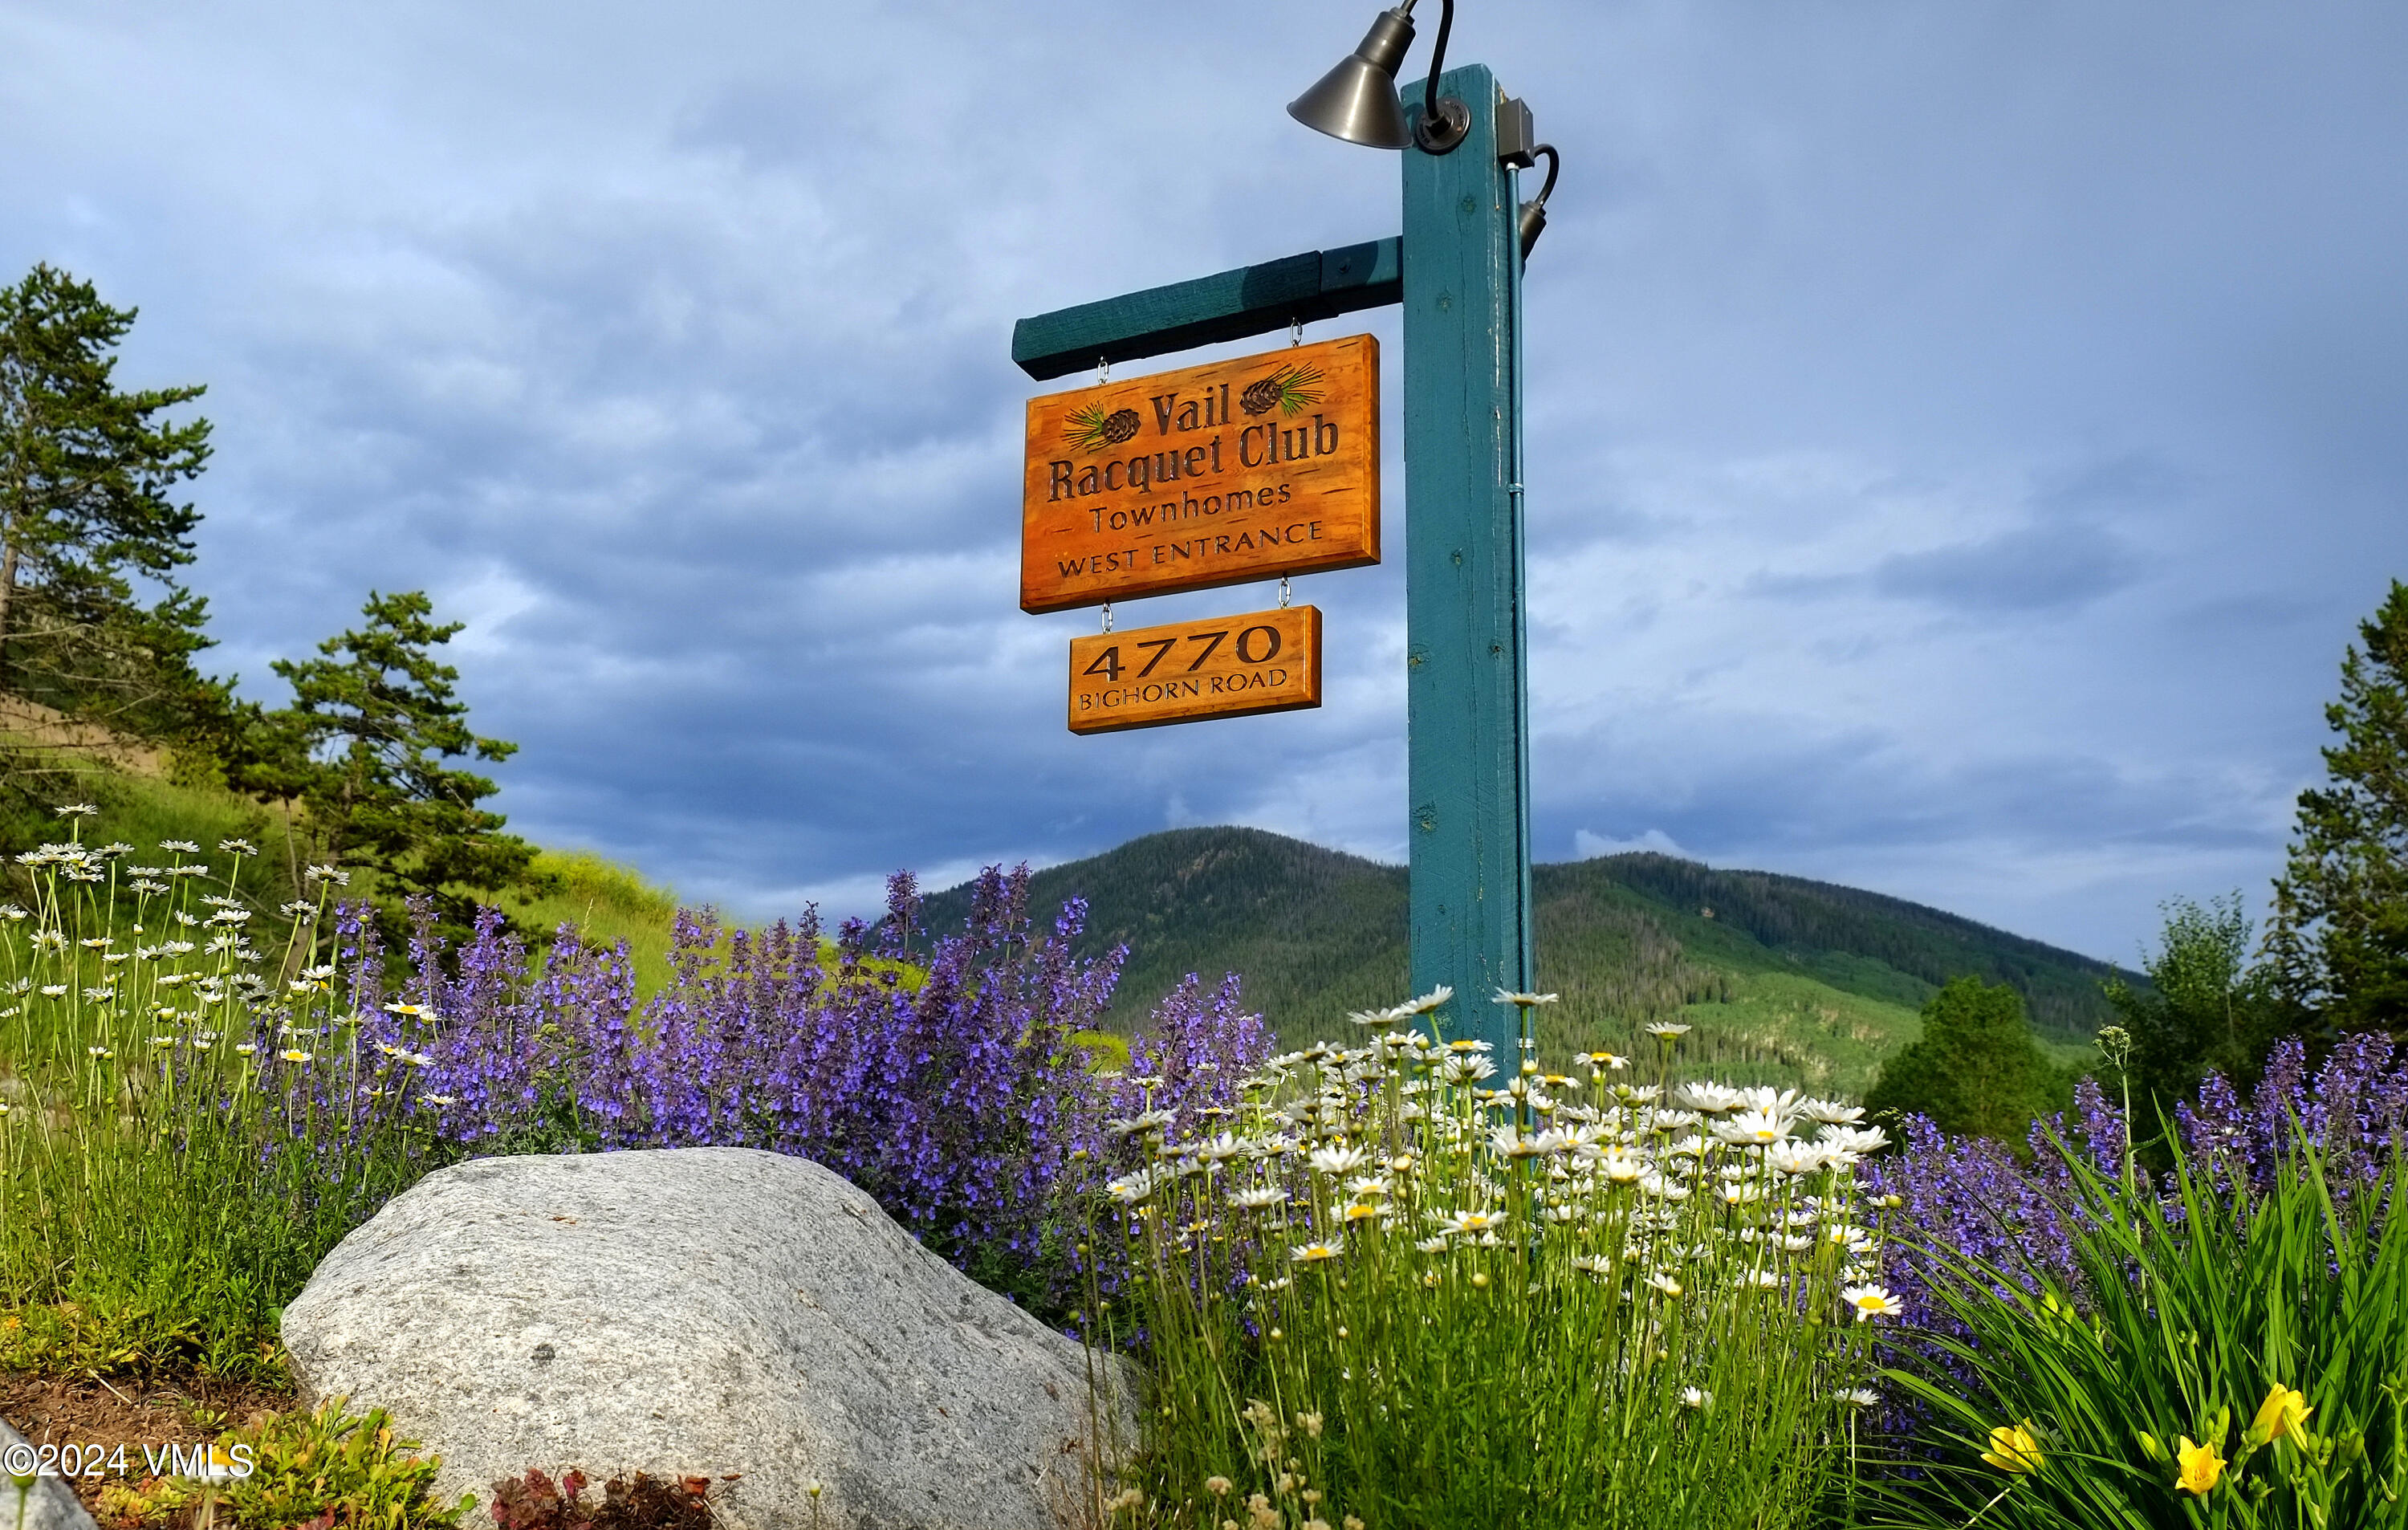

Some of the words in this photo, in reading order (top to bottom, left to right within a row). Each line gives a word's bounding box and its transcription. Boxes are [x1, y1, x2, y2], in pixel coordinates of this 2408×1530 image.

[1149, 383, 1230, 436] Vail
[1047, 435, 1225, 503] Racquet
[1239, 413, 1339, 468] Club
[1089, 483, 1291, 533] Townhomes
[1057, 548, 1139, 578] WEST
[1152, 520, 1323, 564] ENTRANCE
[1082, 625, 1282, 682] 4770
[1079, 679, 1199, 711] BIGHORN
[1210, 669, 1287, 694] ROAD
